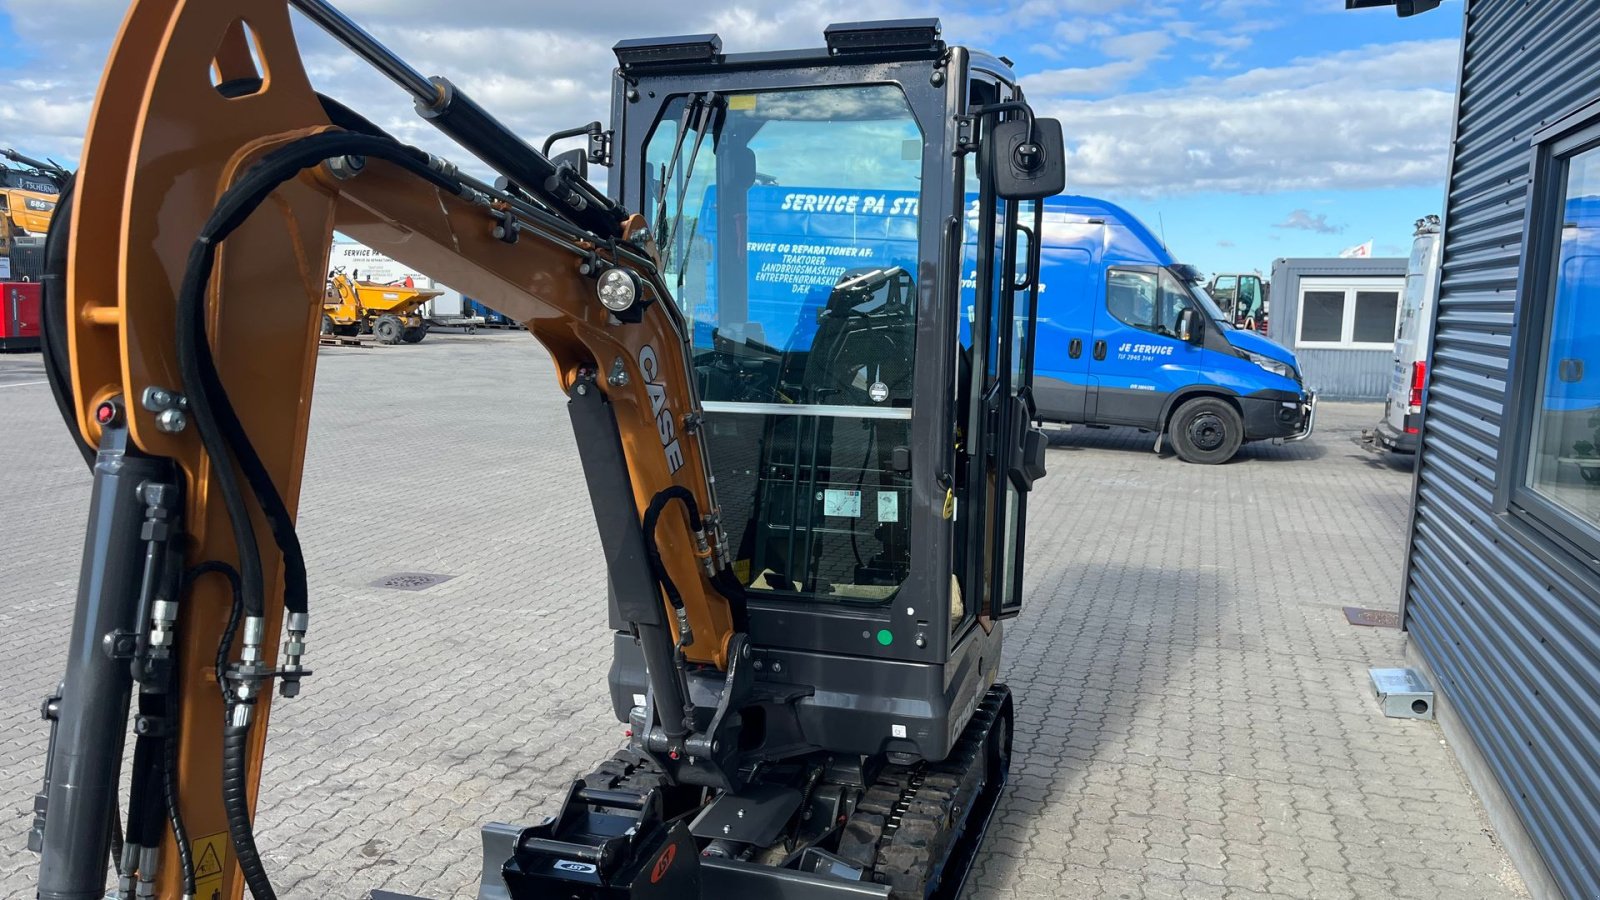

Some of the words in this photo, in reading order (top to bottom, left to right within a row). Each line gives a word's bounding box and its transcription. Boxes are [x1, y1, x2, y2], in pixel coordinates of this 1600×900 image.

[781, 193, 858, 213] SERVICE
[862, 194, 885, 214] PÅ
[344, 249, 370, 257] SERVICE
[747, 242, 776, 253] ERVICE
[778, 243, 791, 253] OG
[791, 244, 860, 257] REPARATIONER
[859, 248, 873, 258] AF:
[782, 254, 826, 266] TRAKTORER
[792, 284, 811, 294] DÆK
[1119, 343, 1132, 353] JE
[1133, 344, 1174, 355] SERVICE
[638, 344, 685, 476] CASE
